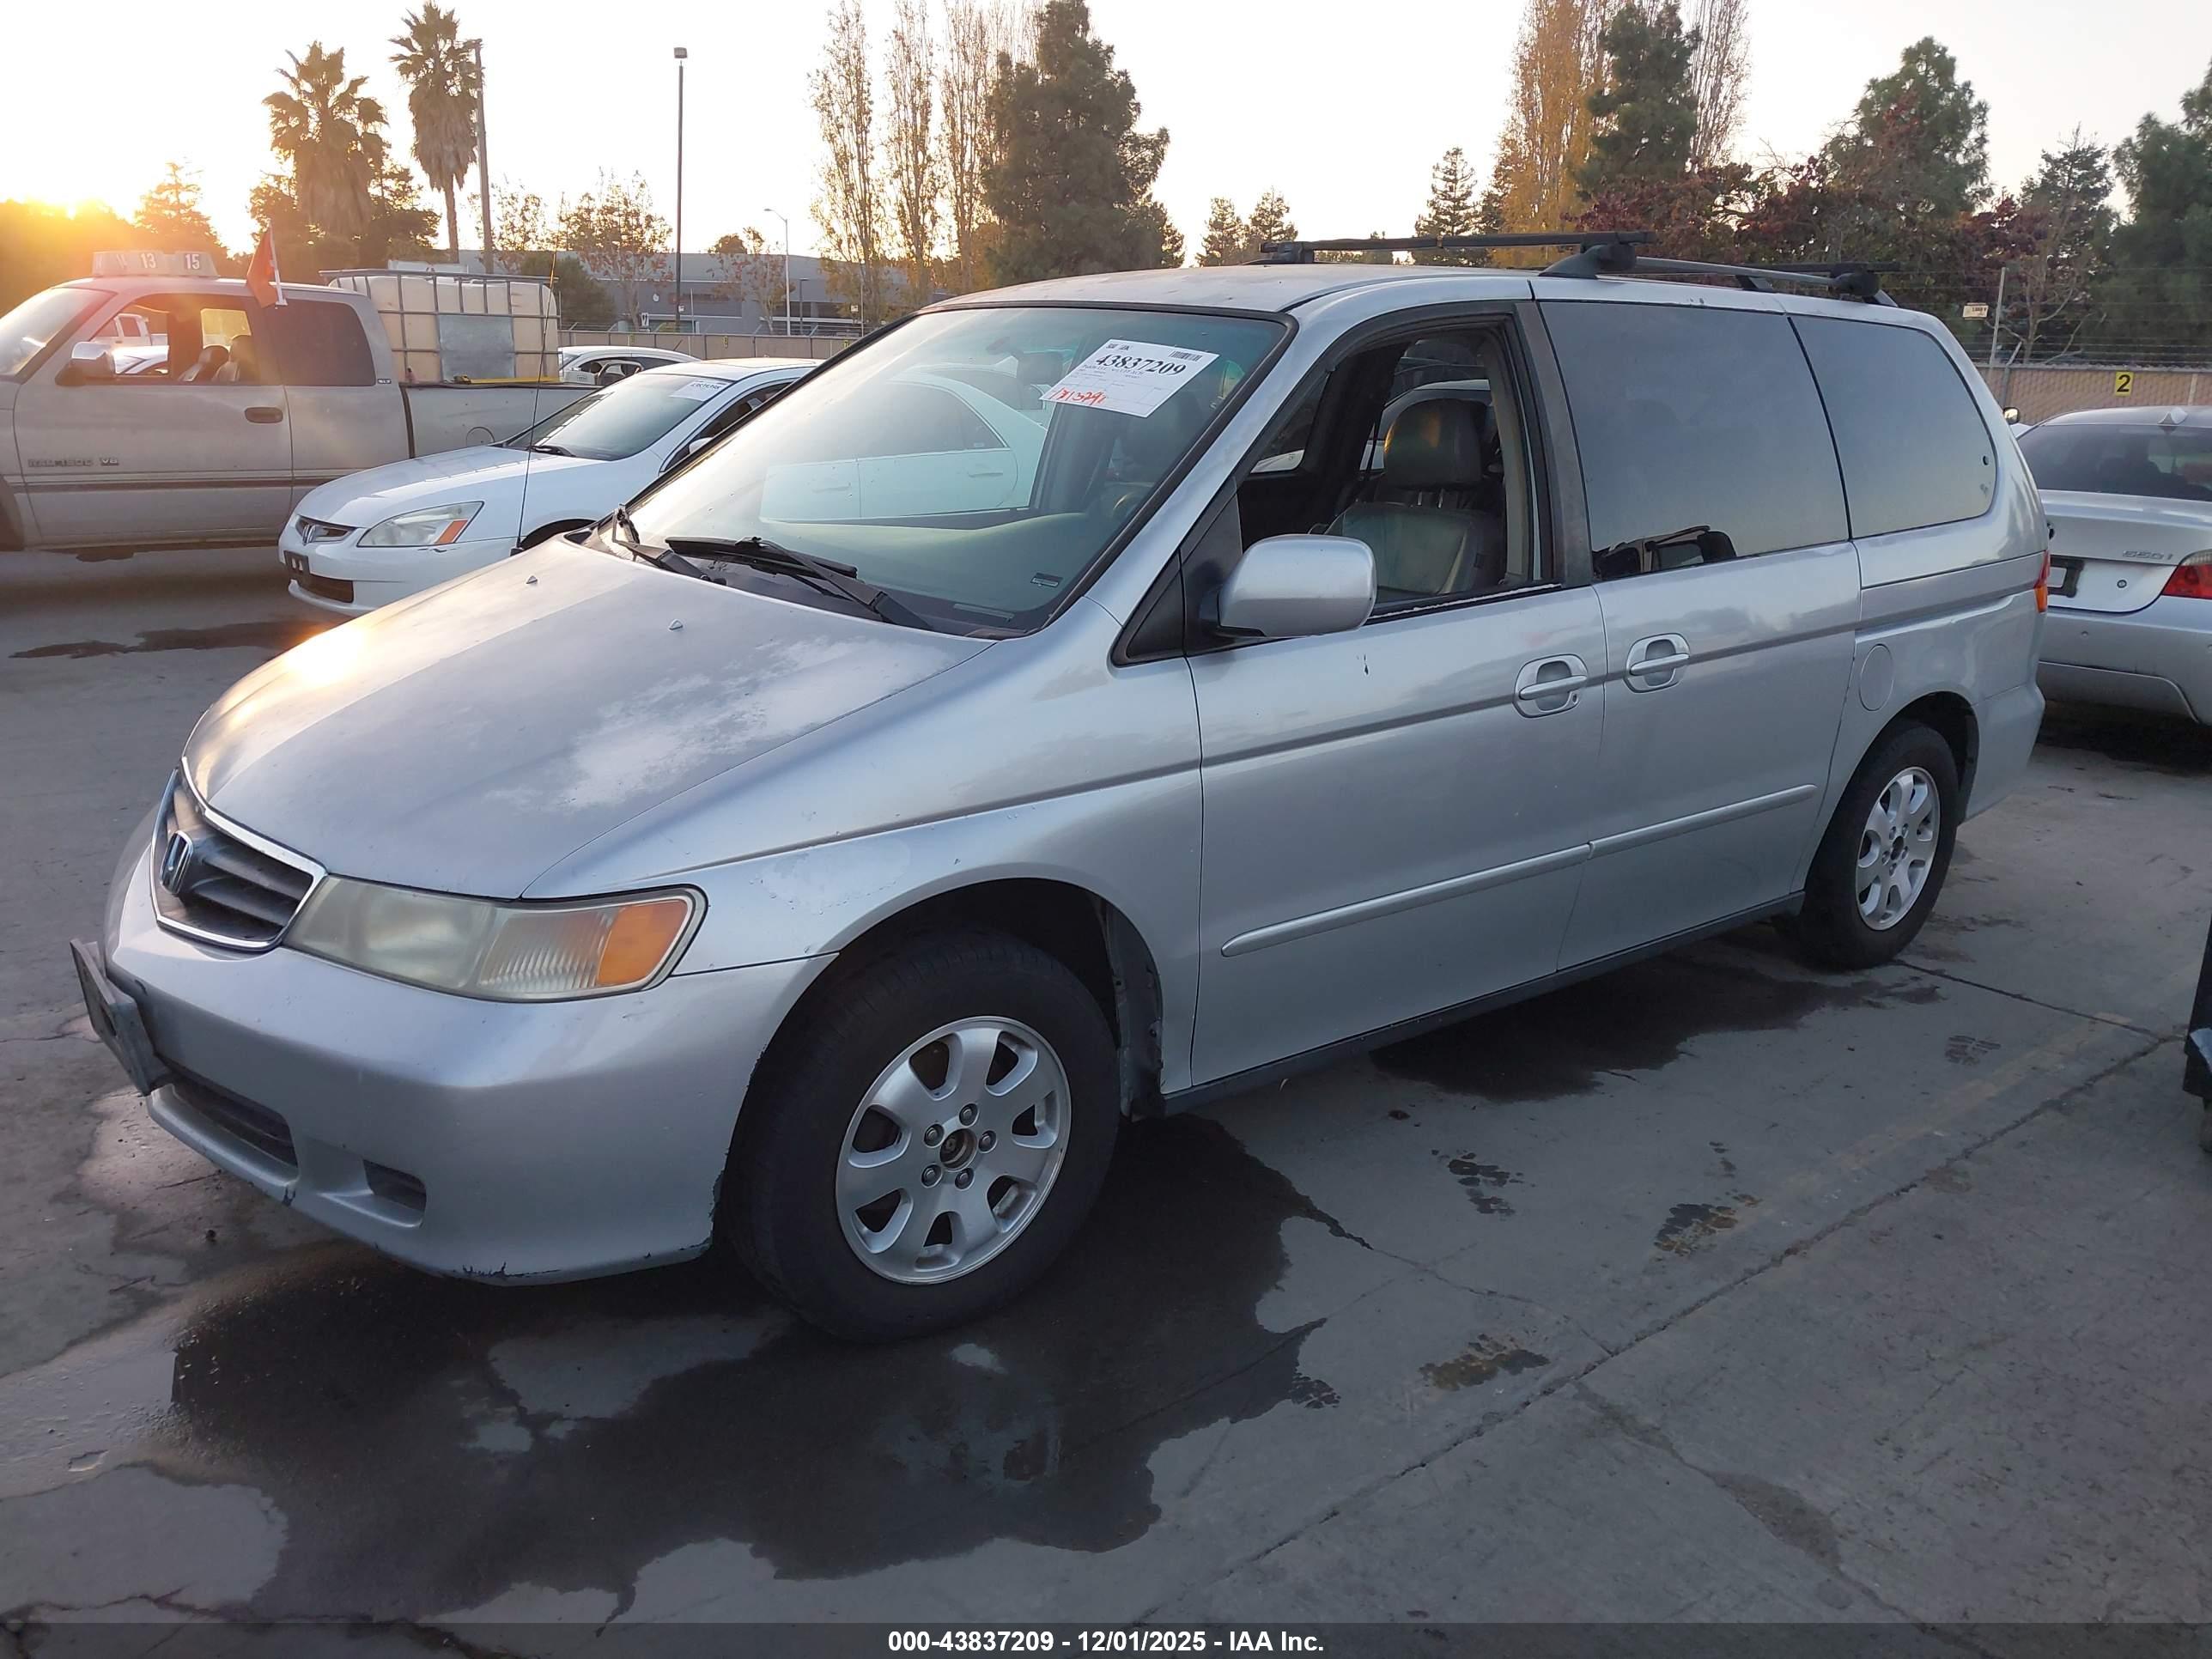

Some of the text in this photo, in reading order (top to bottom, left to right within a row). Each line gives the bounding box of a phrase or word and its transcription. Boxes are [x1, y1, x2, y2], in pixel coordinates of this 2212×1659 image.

[185, 253, 200, 270] 15
[1096, 354, 1187, 375] 43837209
[2117, 374, 2130, 392] 2
